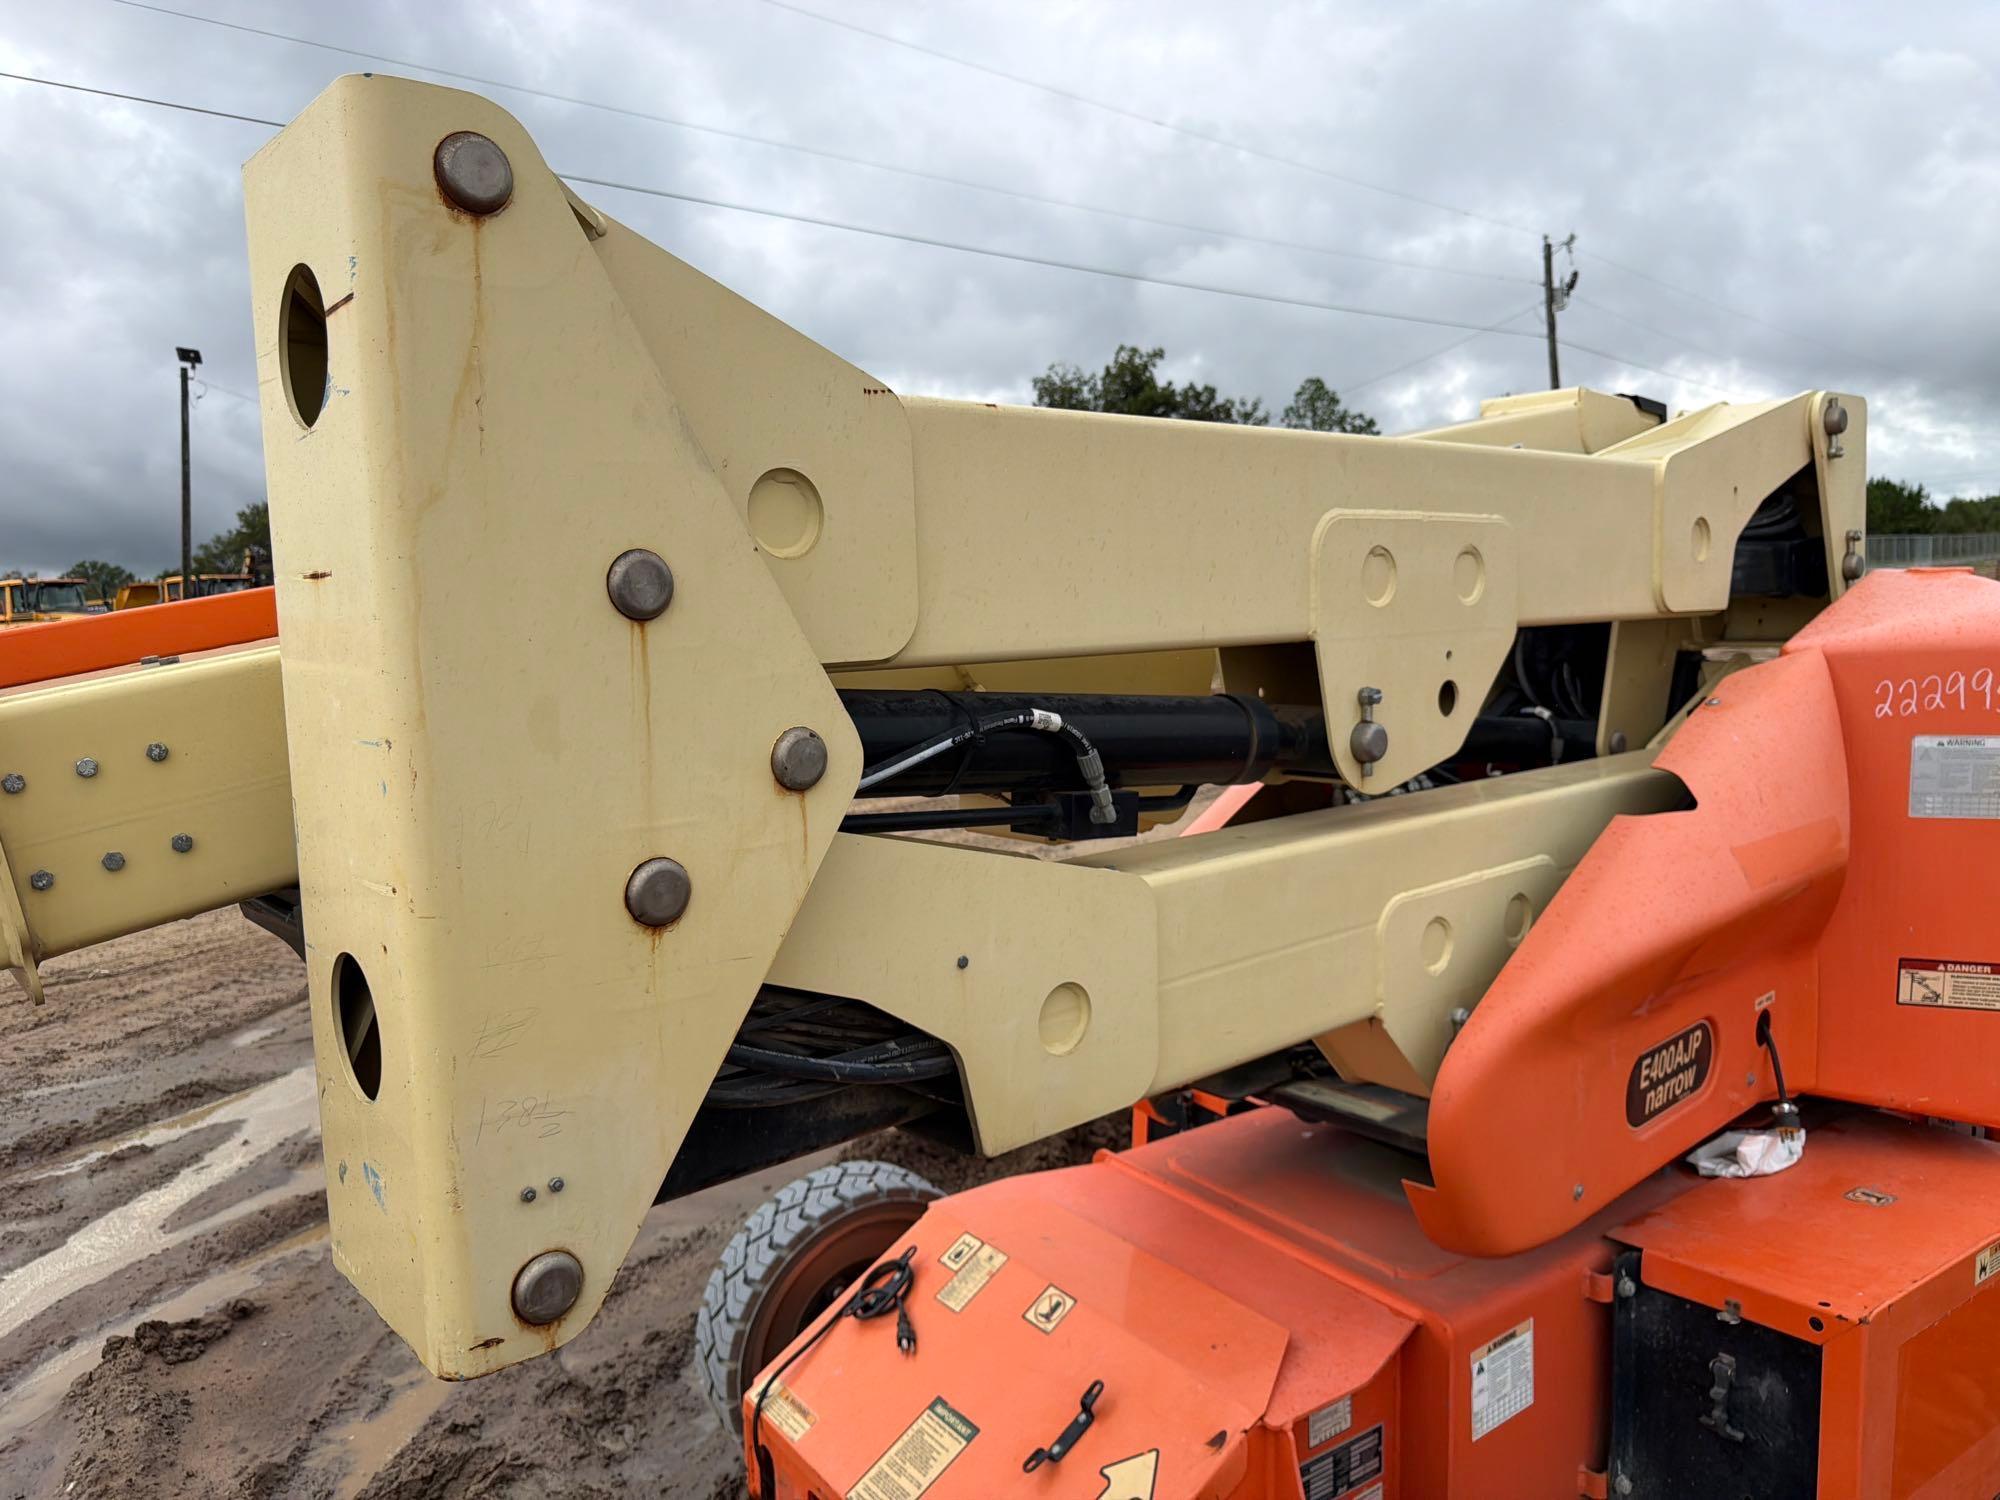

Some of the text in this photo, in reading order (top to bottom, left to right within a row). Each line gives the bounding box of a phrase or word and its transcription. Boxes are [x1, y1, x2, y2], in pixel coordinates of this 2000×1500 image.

[1875, 667, 2000, 719] 22299
[1946, 963, 1992, 975] DANGER
[1639, 1028, 1703, 1091] E400AJP
[1644, 1063, 1697, 1116] narrow
